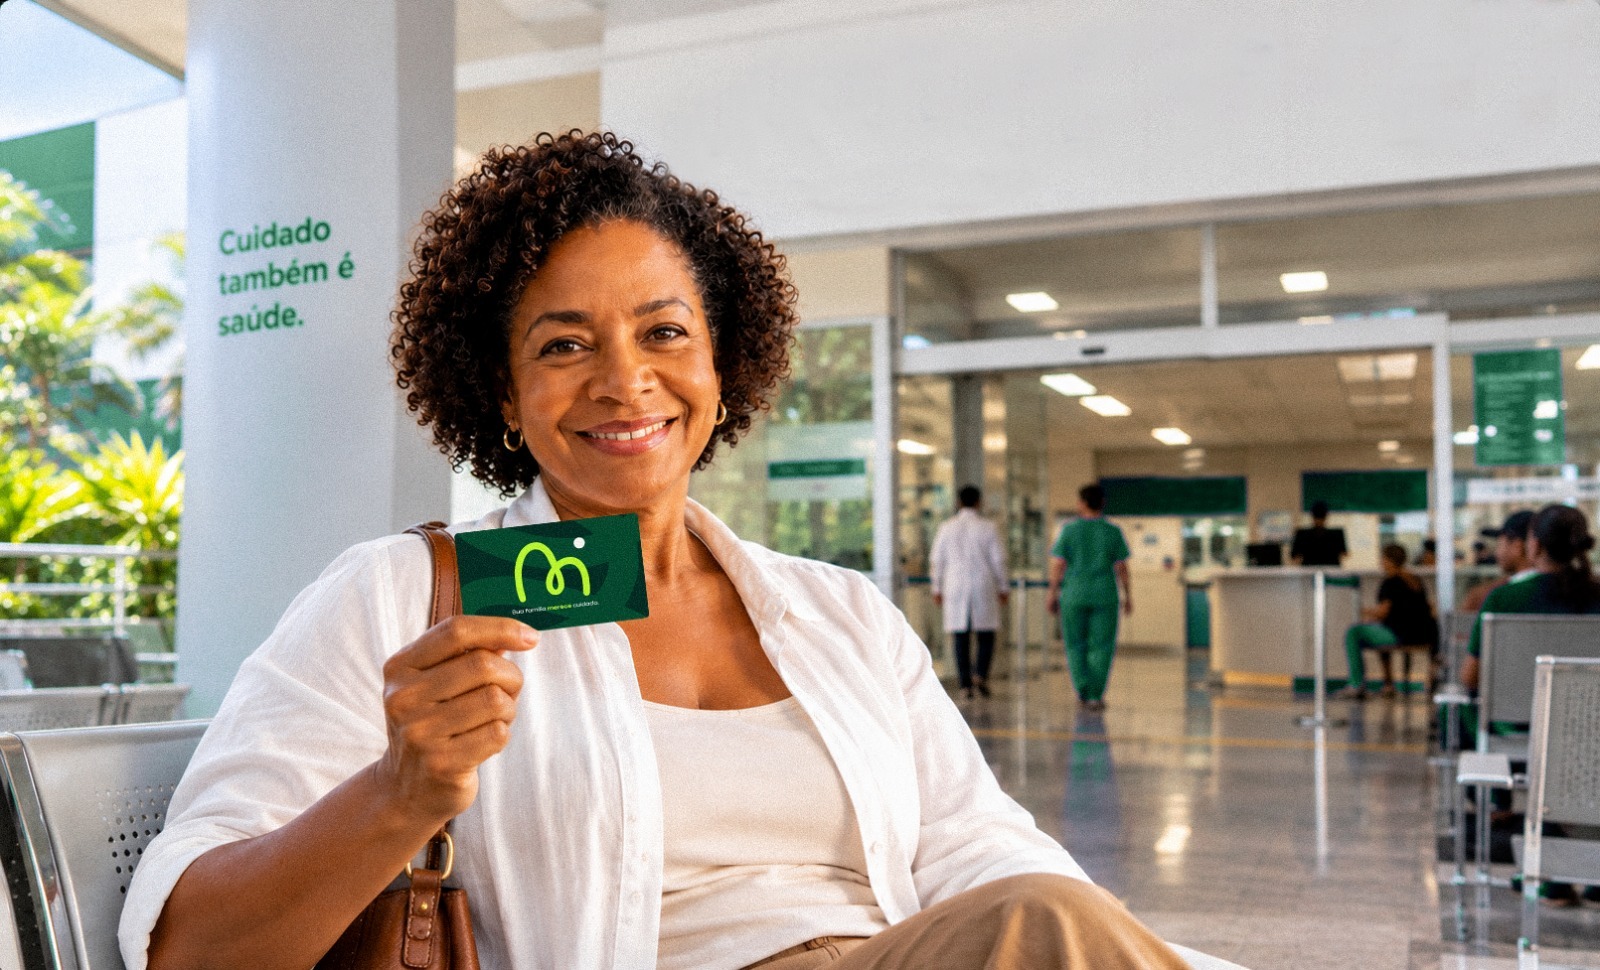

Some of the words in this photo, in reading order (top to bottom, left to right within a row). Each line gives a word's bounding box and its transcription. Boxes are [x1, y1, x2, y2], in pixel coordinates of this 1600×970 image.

[219, 216, 331, 255] Cuidado
[219, 258, 328, 295] também
[337, 251, 355, 279] é
[218, 302, 304, 337] saúde.
